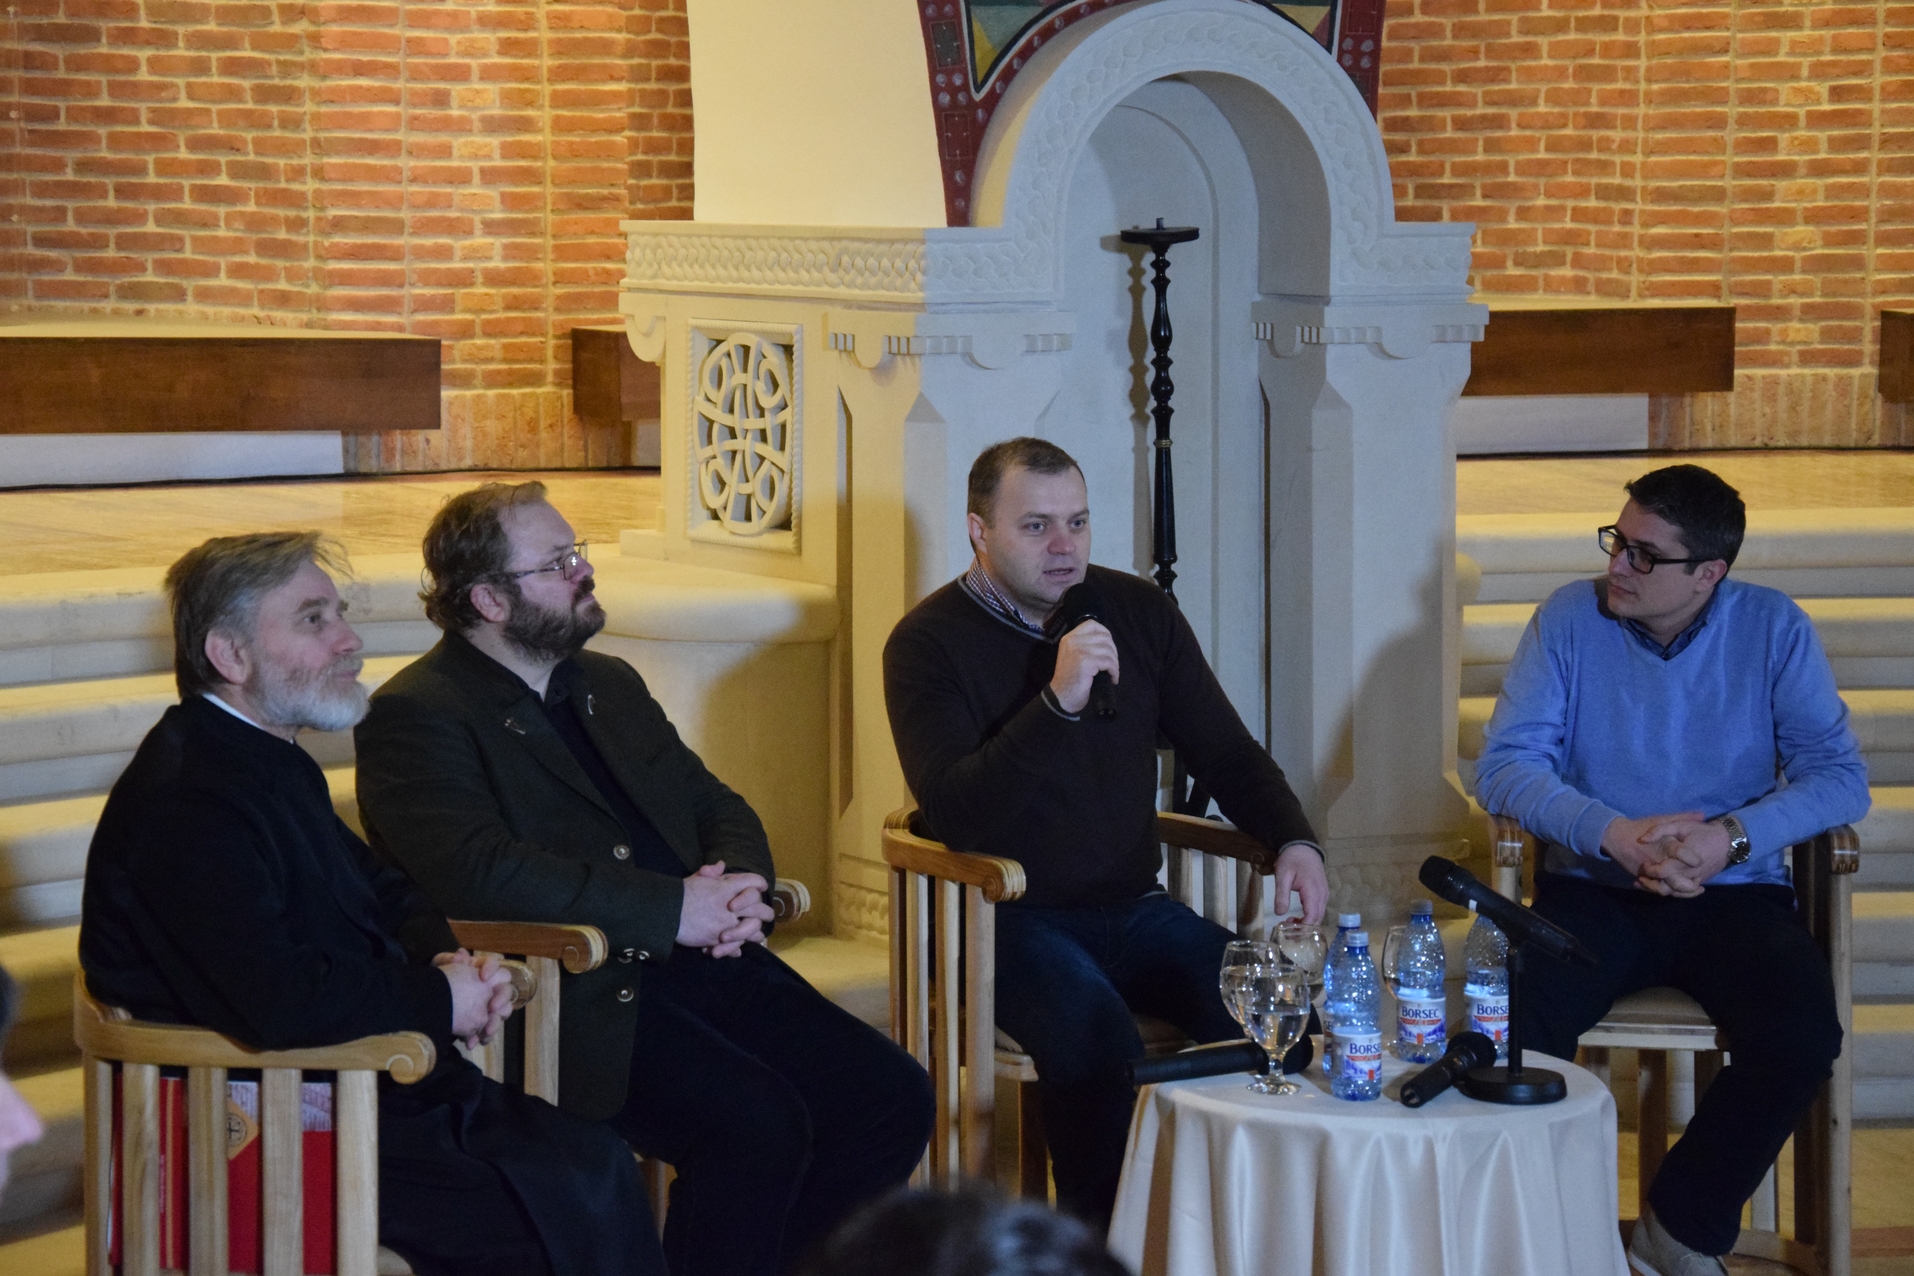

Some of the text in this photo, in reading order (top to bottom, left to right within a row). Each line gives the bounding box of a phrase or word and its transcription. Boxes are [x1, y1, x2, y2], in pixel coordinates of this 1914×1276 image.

[1401, 1005, 1439, 1019] BORSEC
[1476, 1003, 1509, 1016] BORSE
[1349, 1042, 1382, 1055] BORSE
